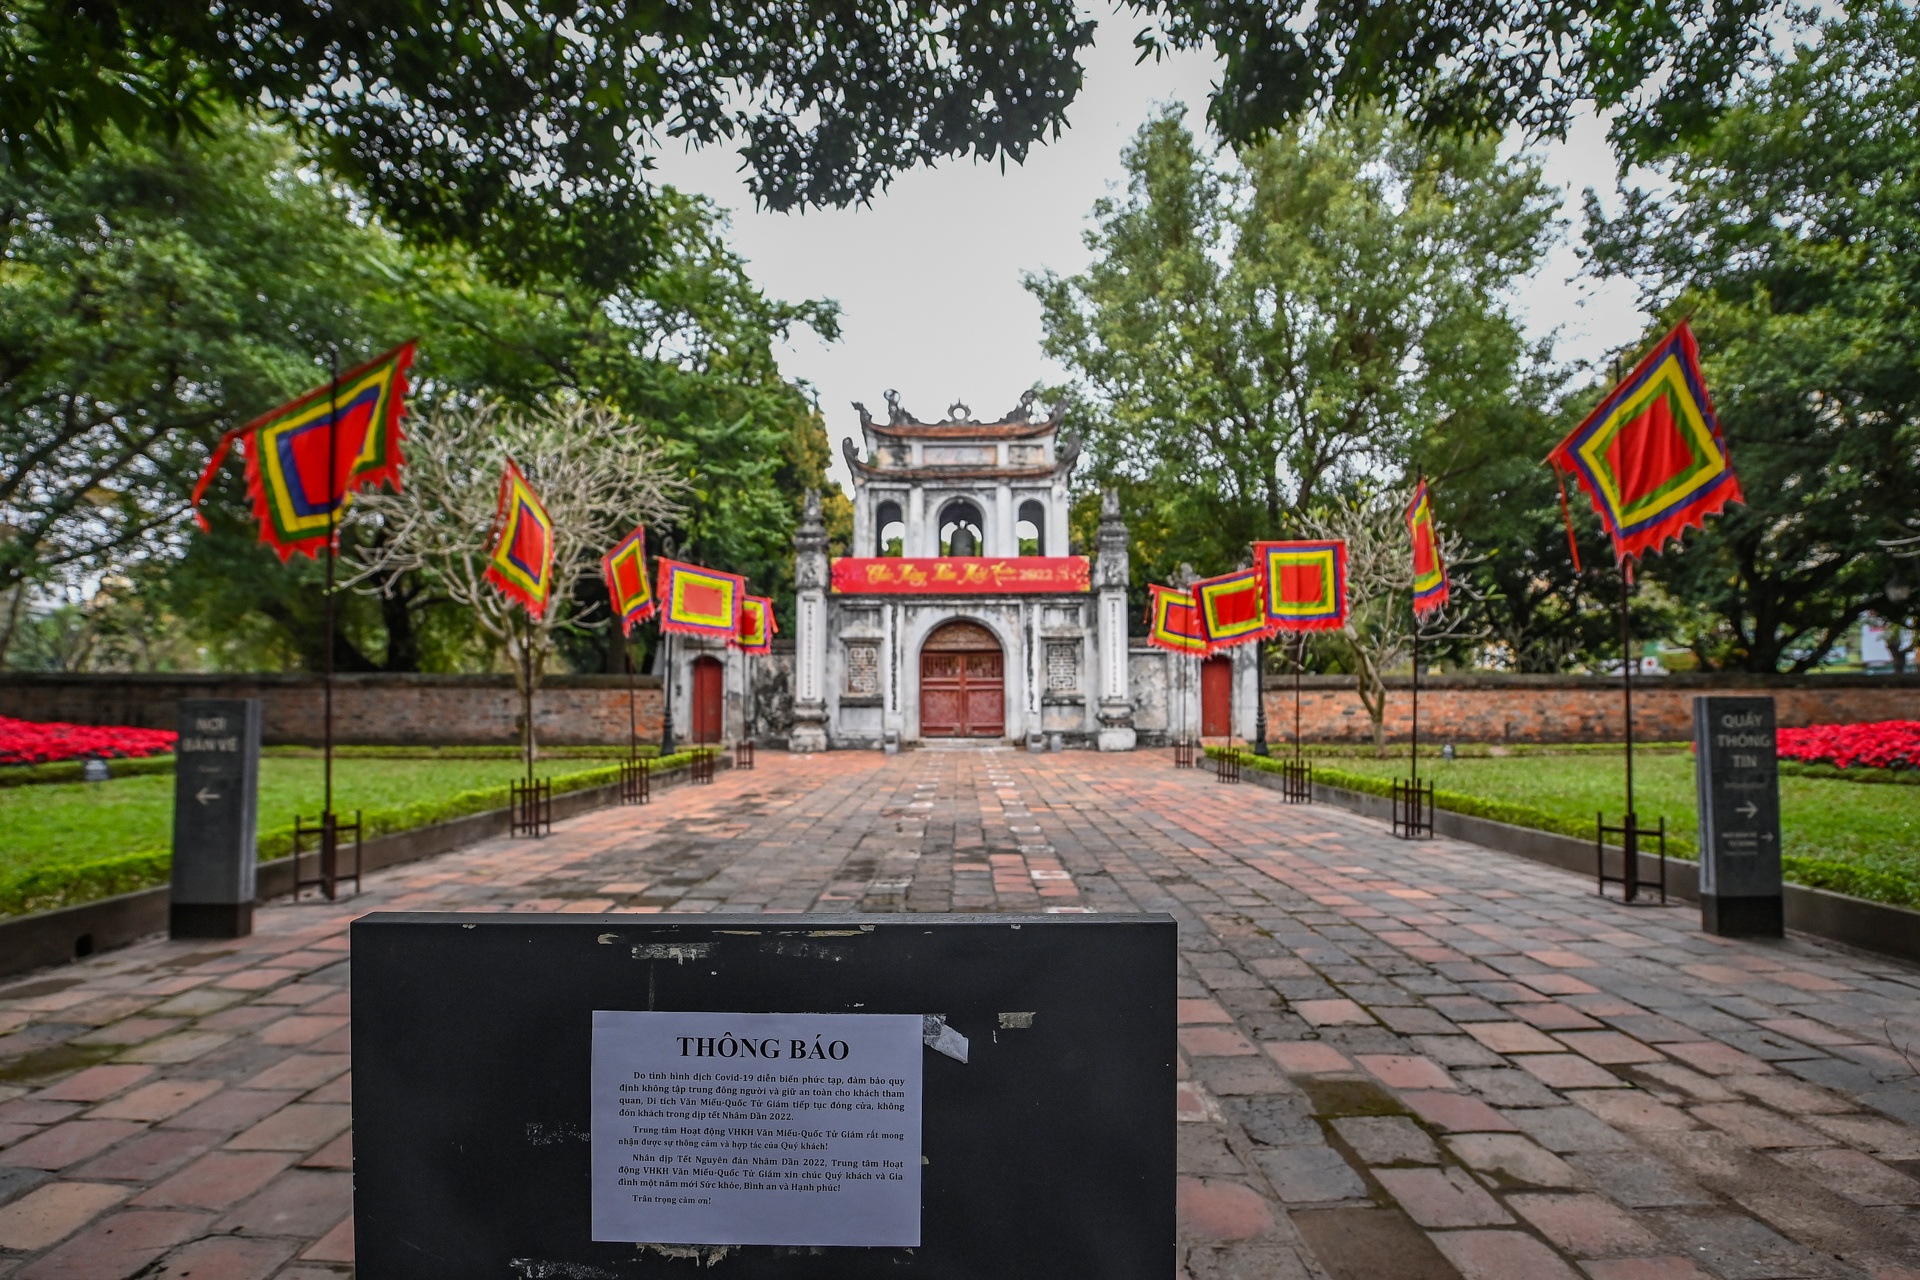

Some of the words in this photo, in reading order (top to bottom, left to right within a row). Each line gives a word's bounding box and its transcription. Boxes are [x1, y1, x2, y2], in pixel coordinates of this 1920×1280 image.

[1019, 568, 1054, 581] 2022
[1716, 733, 1771, 748] THÔNG
[1731, 754, 1758, 767] TIN
[676, 1032, 781, 1058] THÔNG
[789, 1035, 849, 1061] BÁO
[634, 1071, 646, 1080] Do
[649, 1071, 666, 1080] tình
[670, 1072, 690, 1080] hình
[693, 1072, 712, 1083] dịch
[715, 1073, 754, 1082] Covid-19
[757, 1073, 776, 1083] diễn
[779, 1074, 799, 1083] biến
[802, 1075, 825, 1085] phức
[828, 1077, 844, 1086] tạp,
[847, 1076, 866, 1084] đảm
[869, 1076, 886, 1085] bảo
[888, 1079, 905, 1087] quy
[619, 1083, 639, 1093] định
[642, 1084, 669, 1094] không
[672, 1084, 686, 1095] tập
[689, 1086, 713, 1096] trung
[715, 1085, 737, 1096] đông
[740, 1086, 766, 1097] người
[769, 1087, 779, 1095] và
[781, 1087, 797, 1098] giữ
[813, 1088, 832, 1096] toàn
[835, 1088, 850, 1097] cho
[853, 1088, 879, 1097] khách
[882, 1089, 905, 1098] tham
[619, 1098, 643, 1106] quan,
[647, 1097, 656, 1105] Di
[660, 1097, 676, 1105] tích
[680, 1097, 696, 1106] Văn
[700, 1097, 747, 1109] Miếu-Quốc
[750, 1099, 763, 1108] Tử
[766, 1099, 789, 1108] Giám
[793, 1099, 810, 1110] tiếp
[813, 1101, 827, 1111] tục
[830, 1101, 852, 1112] đóng
[855, 1101, 874, 1111] cửa,
[877, 1102, 905, 1113] không
[619, 1108, 635, 1117] đón
[638, 1109, 664, 1118] khách
[666, 1110, 690, 1120] trong
[692, 1110, 706, 1121] dịp
[708, 1110, 720, 1119] tết
[722, 1111, 747, 1120] Nhâm
[750, 1111, 767, 1120] Dần
[769, 1112, 794, 1121] 2022.
[633, 1125, 659, 1135] Trung
[661, 1126, 677, 1134] tâm
[680, 1127, 701, 1137] Hoạt
[703, 1127, 725, 1137] động
[728, 1128, 754, 1136] VHKH
[756, 1128, 773, 1136] Văn
[776, 1128, 823, 1139] Miếu-Quốc
[825, 1129, 838, 1138] Tử
[841, 1130, 863, 1139] Giám
[866, 1129, 878, 1139] rất
[881, 1133, 904, 1141] mong
[618, 1137, 639, 1147] nhận
[641, 1138, 662, 1148] được
[664, 1140, 674, 1148] sự
[676, 1138, 699, 1149] thông
[701, 1139, 718, 1148] cảm
[720, 1140, 729, 1148] và
[732, 1140, 748, 1150] hợp
[750, 1140, 762, 1149] tác
[764, 1141, 778, 1149] của
[781, 1141, 798, 1151] Quý
[801, 1142, 828, 1150] khách!
[633, 1153, 655, 1162] Nhân
[659, 1154, 673, 1164] dịp
[677, 1154, 691, 1163] Tết
[696, 1155, 728, 1166] Nguyên
[732, 1156, 748, 1165] đán
[752, 1157, 777, 1165] Nhâm
[782, 1157, 799, 1166] Dần
[803, 1158, 827, 1168] 2022,
[831, 1159, 858, 1169] Trung
[862, 1159, 879, 1168] tâm
[883, 1160, 903, 1170] Hoạt
[618, 1165, 640, 1176] động
[643, 1166, 669, 1175] VHKH
[672, 1167, 689, 1175] Văn
[692, 1167, 739, 1178] Miếu-Quốc
[742, 1169, 755, 1178] Tử
[758, 1169, 781, 1178] Giám
[784, 1170, 798, 1178] xin
[801, 1170, 822, 1179] chúc
[825, 1171, 842, 1182] Quý
[846, 1171, 872, 1180] khách
[875, 1172, 885, 1180] và
[889, 1172, 903, 1181] Gia
[618, 1177, 638, 1186] đình
[640, 1178, 657, 1188] một
[659, 1179, 678, 1187] năm
[680, 1180, 698, 1188] mới
[700, 1180, 716, 1189] Sức
[718, 1181, 742, 1190] khỏe,
[744, 1181, 764, 1190] Bình
[779, 1182, 789, 1191] và
[791, 1183, 814, 1193] Hạnh
[816, 1183, 840, 1194] phúc!
[632, 1194, 652, 1203] Trân
[655, 1196, 677, 1205] trọng
[678, 1196, 695, 1204] cảm
[698, 1197, 711, 1205] ơn!
